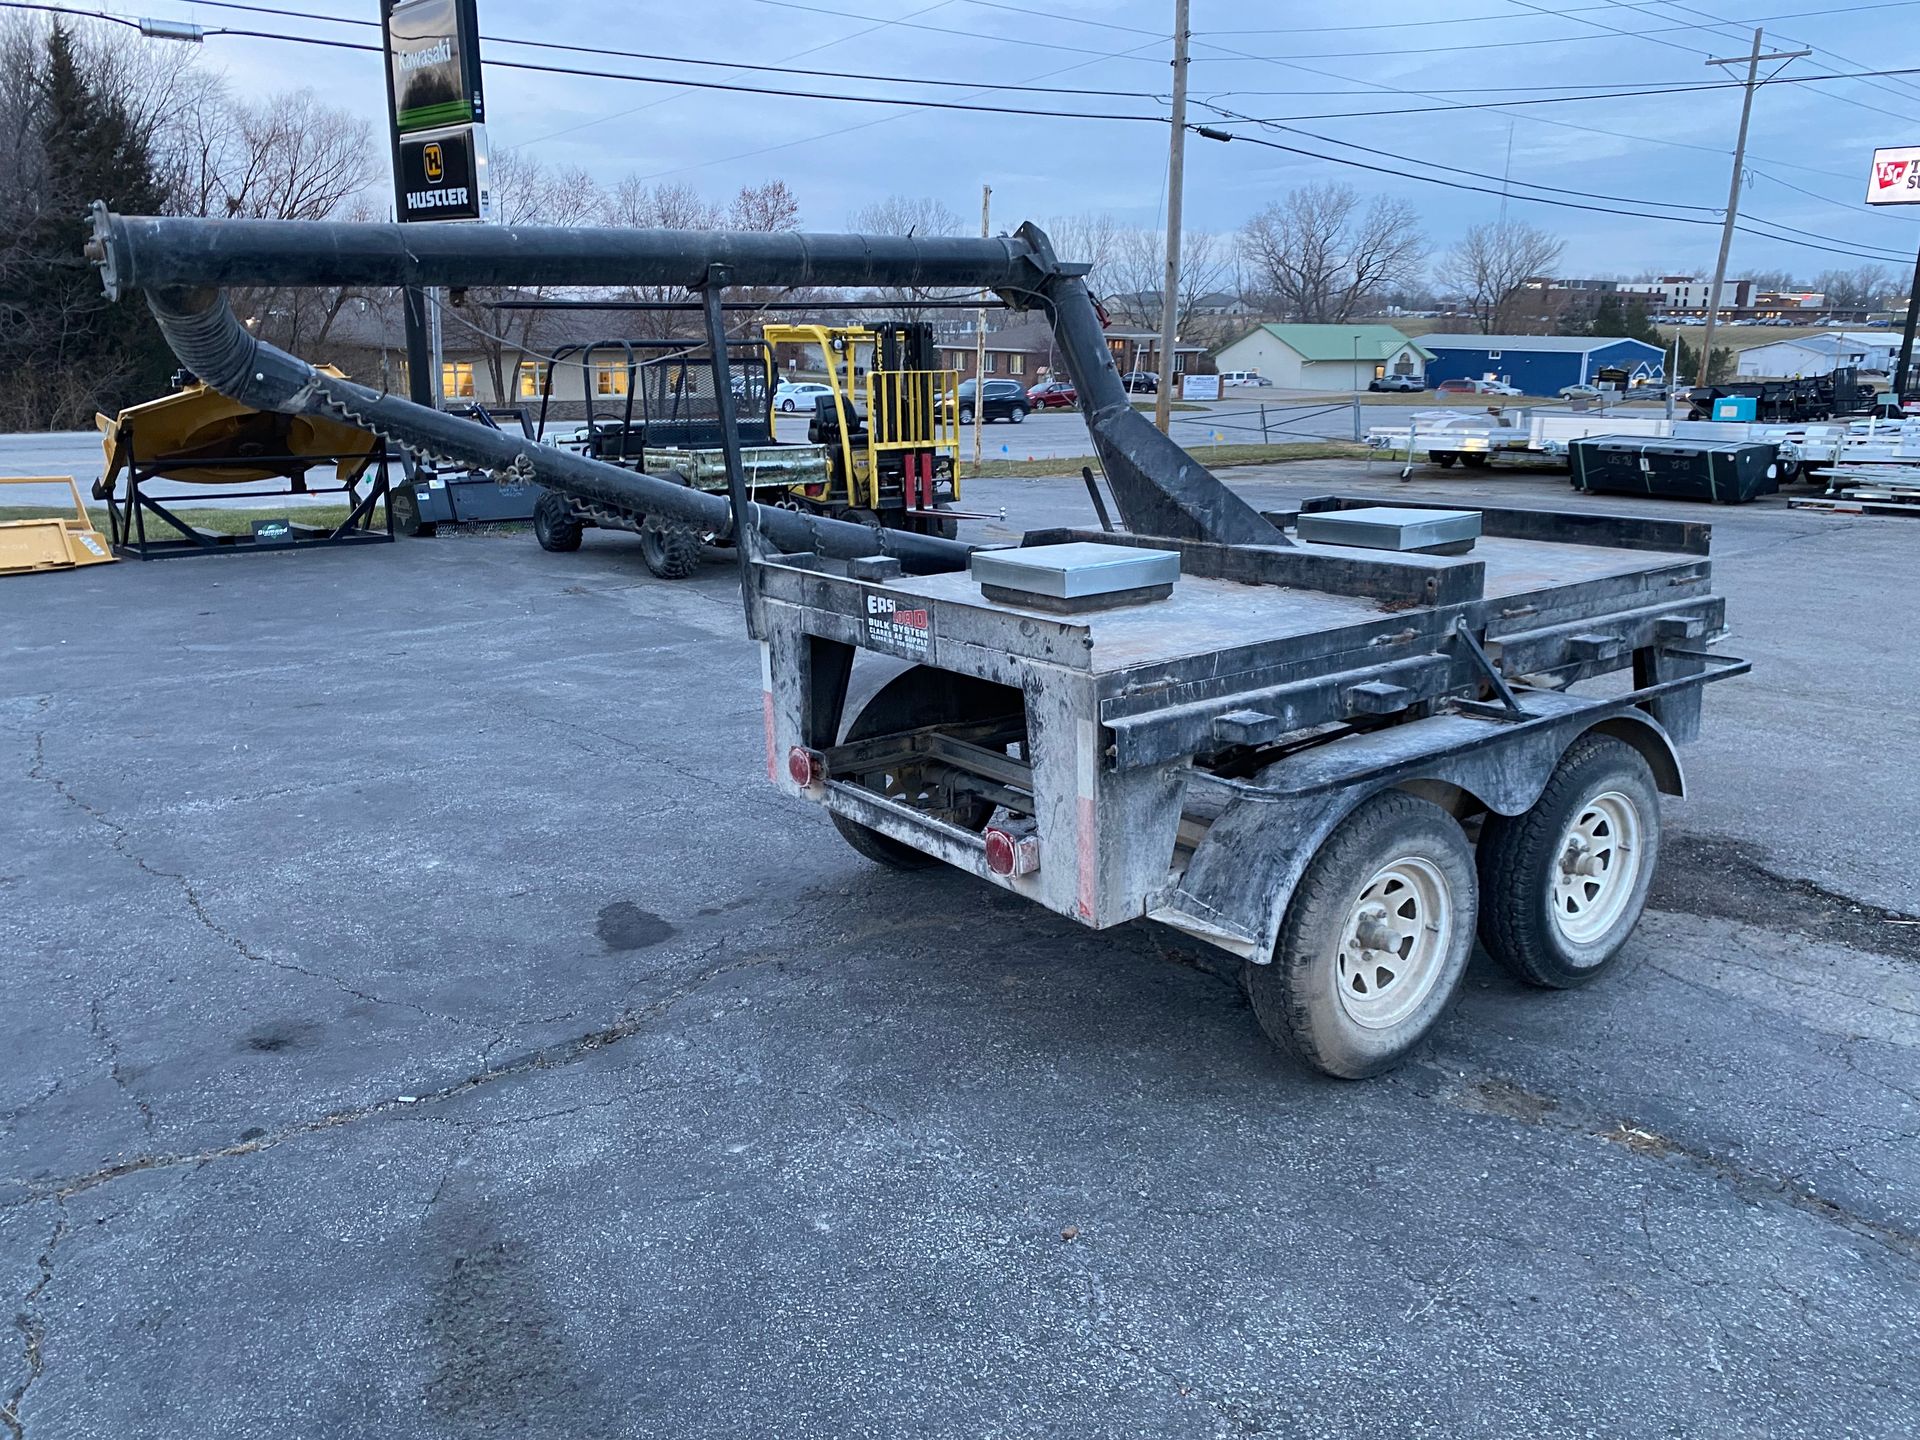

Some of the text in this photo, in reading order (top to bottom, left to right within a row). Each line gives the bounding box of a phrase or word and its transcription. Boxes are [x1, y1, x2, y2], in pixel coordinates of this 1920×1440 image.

[398, 38, 451, 71] Kawasaki
[1878, 162, 1903, 184] TSC
[407, 187, 468, 209] HUSTLER
[869, 618, 928, 639] BULK SYSTEM
[904, 636, 928, 647] SUPPLY
